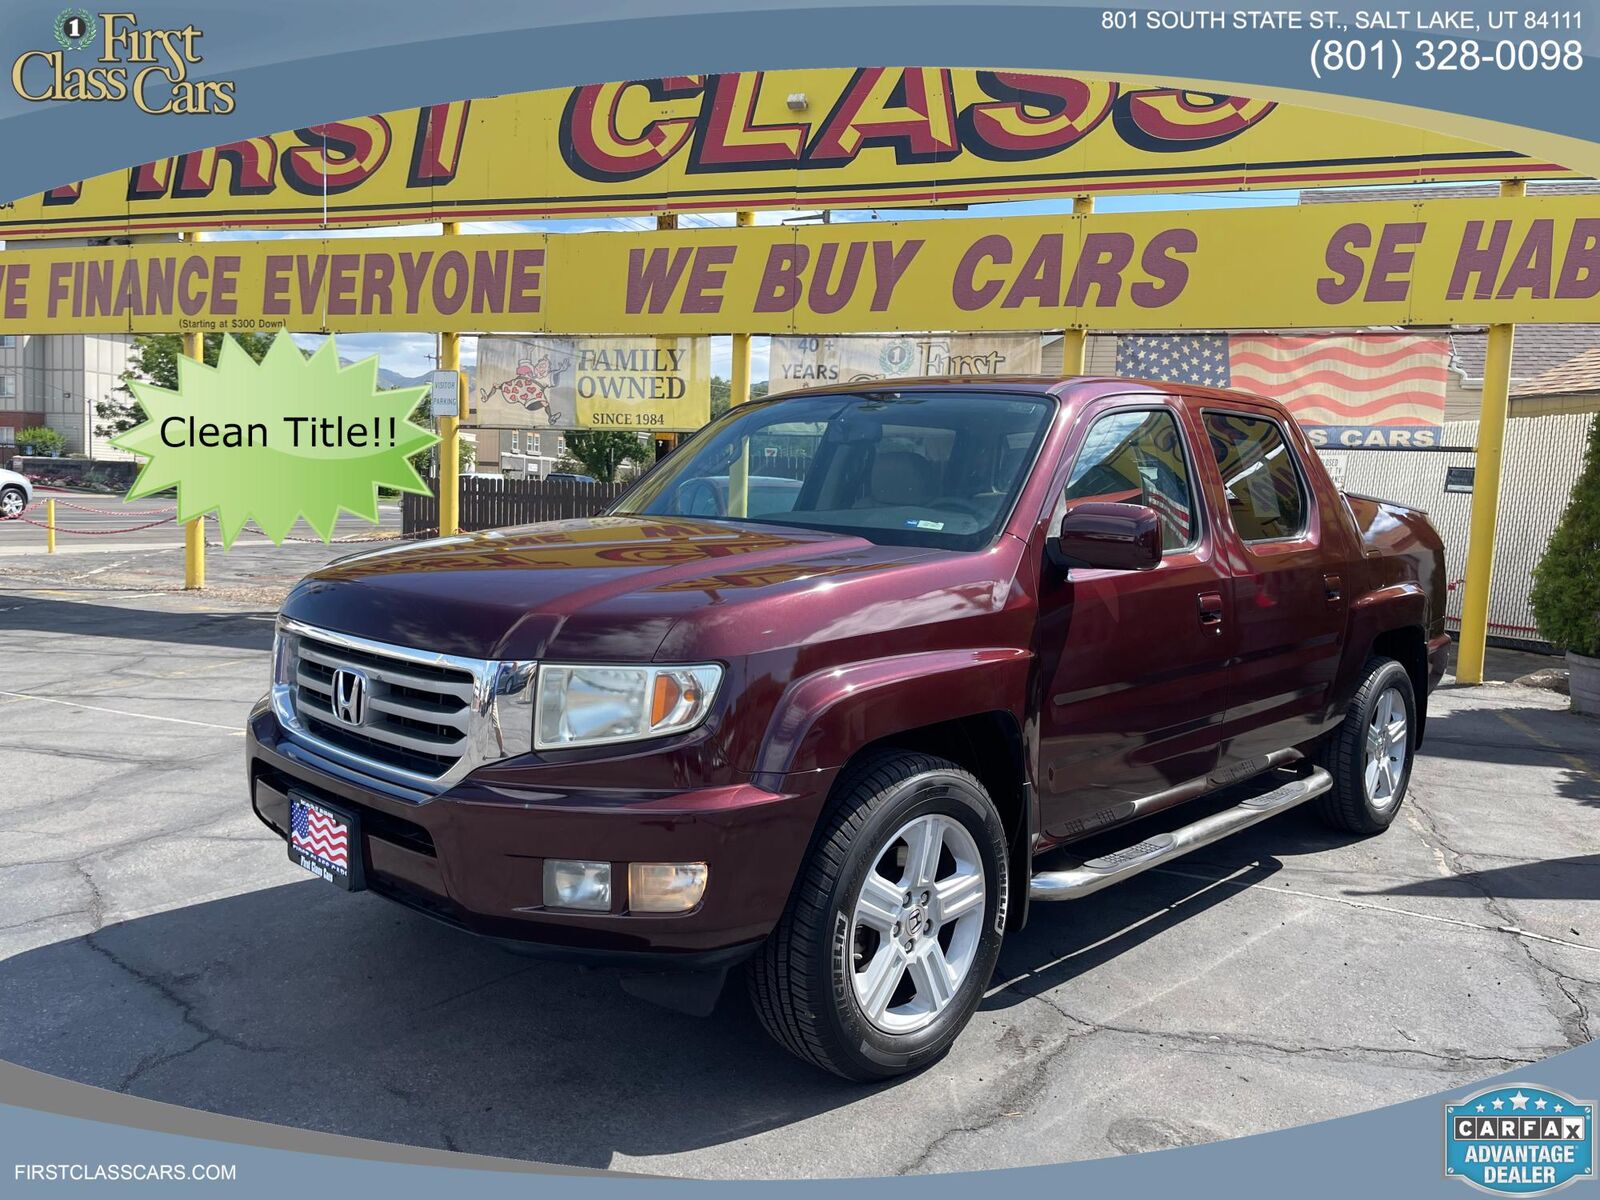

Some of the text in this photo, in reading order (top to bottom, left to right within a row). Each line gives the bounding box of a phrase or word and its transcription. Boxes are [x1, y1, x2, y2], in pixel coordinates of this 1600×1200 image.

[47, 255, 241, 319] FINANCE
[262, 248, 546, 316] EVERYONE
[625, 246, 738, 314] WE
[752, 239, 926, 314] BUY
[952, 228, 1198, 311] CARS
[1316, 222, 1427, 305] SE
[178, 318, 287, 330] (Starting at $300 Down)
[797, 338, 819, 353] 40
[577, 349, 687, 372] FAMILY
[782, 364, 838, 380] YEARS
[577, 376, 686, 400] OWNED
[433, 397, 456, 405] PARKING
[592, 413, 664, 426] SINCE 1984
[1339, 429, 1435, 448] CARS
